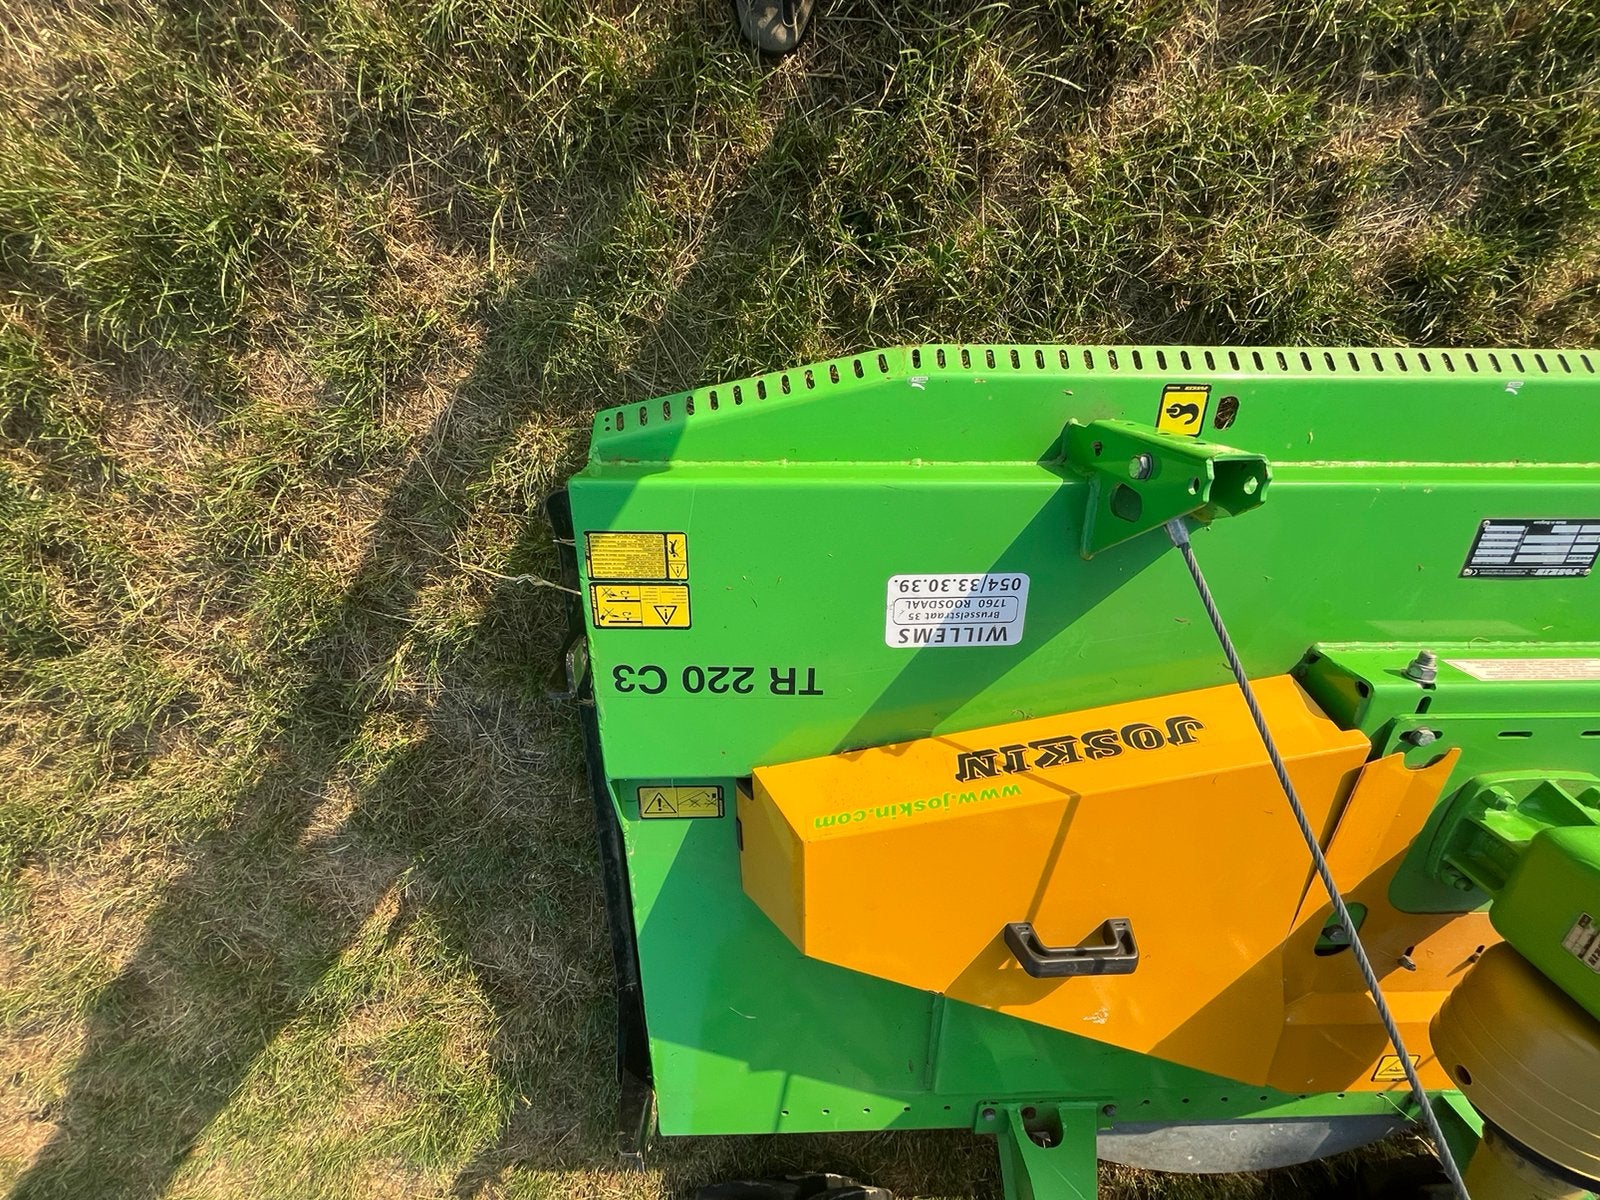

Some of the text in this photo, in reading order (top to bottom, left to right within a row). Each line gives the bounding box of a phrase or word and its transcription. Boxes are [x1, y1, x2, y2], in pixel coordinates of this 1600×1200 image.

[894, 575, 1022, 593] 054/33.30.39.
[905, 598, 1007, 610] 1760 ROOSDAAL
[908, 611, 1000, 621] Brusselstraat 35
[898, 627, 1007, 644] WILLEMS
[612, 664, 824, 696] TR 220 C3
[954, 715, 1206, 784] JOSKIN
[813, 784, 1022, 832] www.joskin.com
